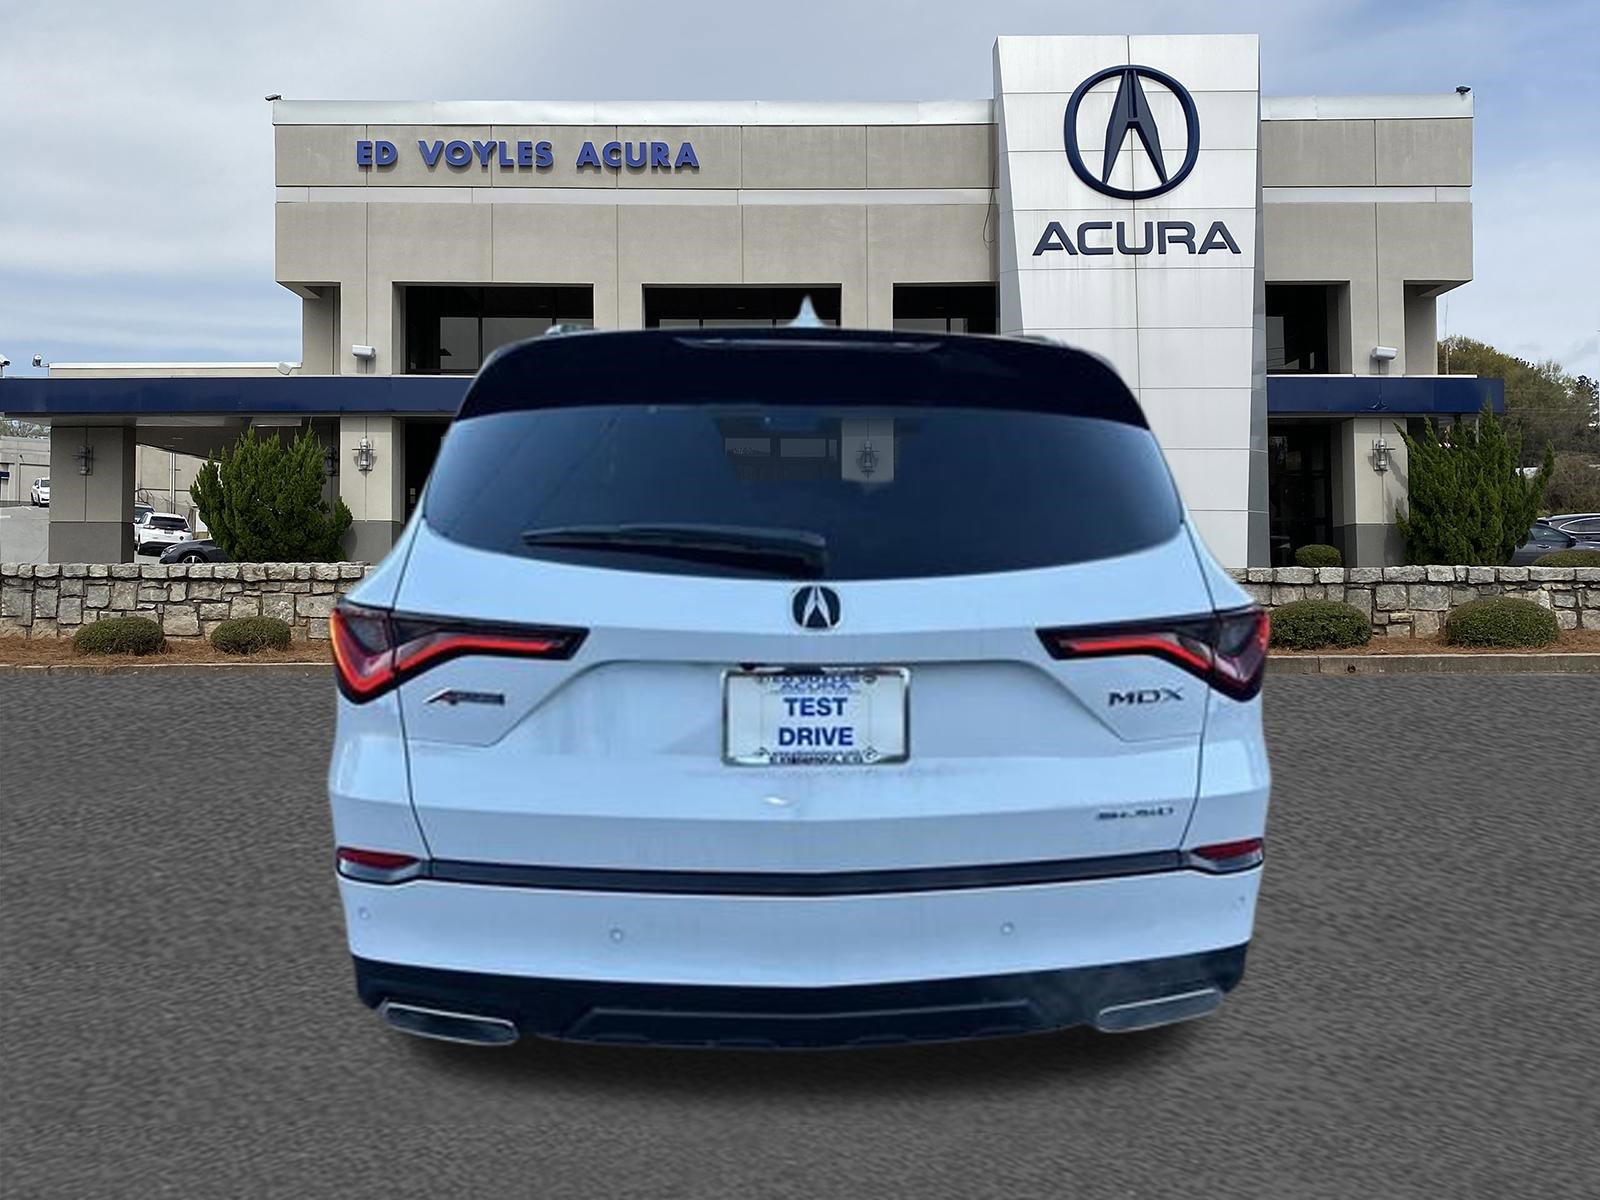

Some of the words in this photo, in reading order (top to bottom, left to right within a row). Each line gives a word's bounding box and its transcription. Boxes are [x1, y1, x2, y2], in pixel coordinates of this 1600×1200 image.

[357, 141, 398, 170] ED
[418, 141, 554, 170] VOYLES
[576, 141, 700, 171] ACURA
[1032, 221, 1242, 256] ACURA
[783, 697, 849, 717] TEST
[1108, 688, 1184, 706] MDX
[778, 727, 854, 746] DRIVE
